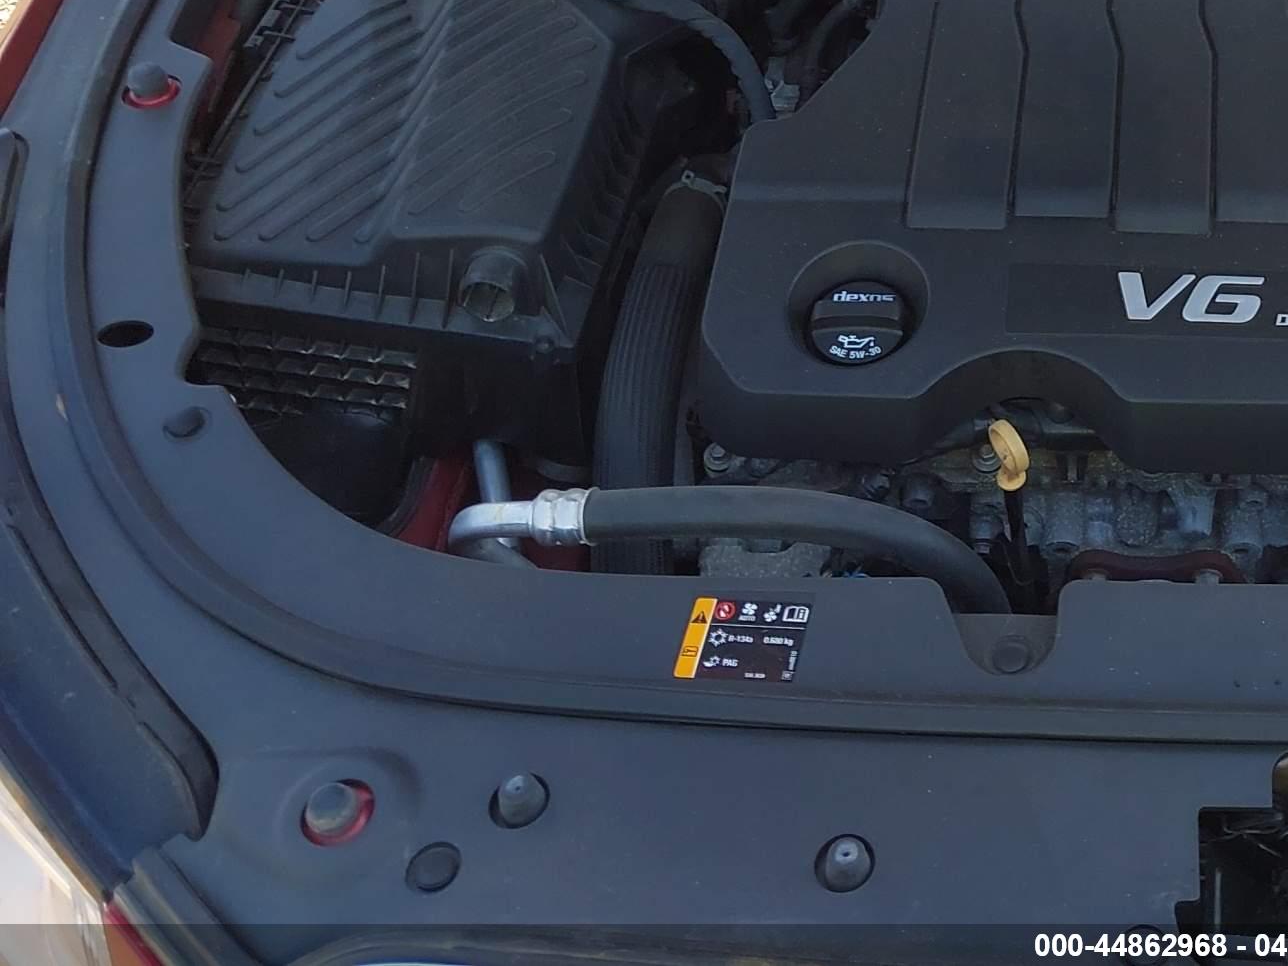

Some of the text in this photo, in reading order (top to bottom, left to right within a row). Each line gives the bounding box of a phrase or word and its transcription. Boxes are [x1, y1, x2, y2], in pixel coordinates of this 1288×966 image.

[1117, 271, 1265, 324] V6
[829, 345, 882, 359] SAE 5W-30
[722, 658, 739, 667] PAG
